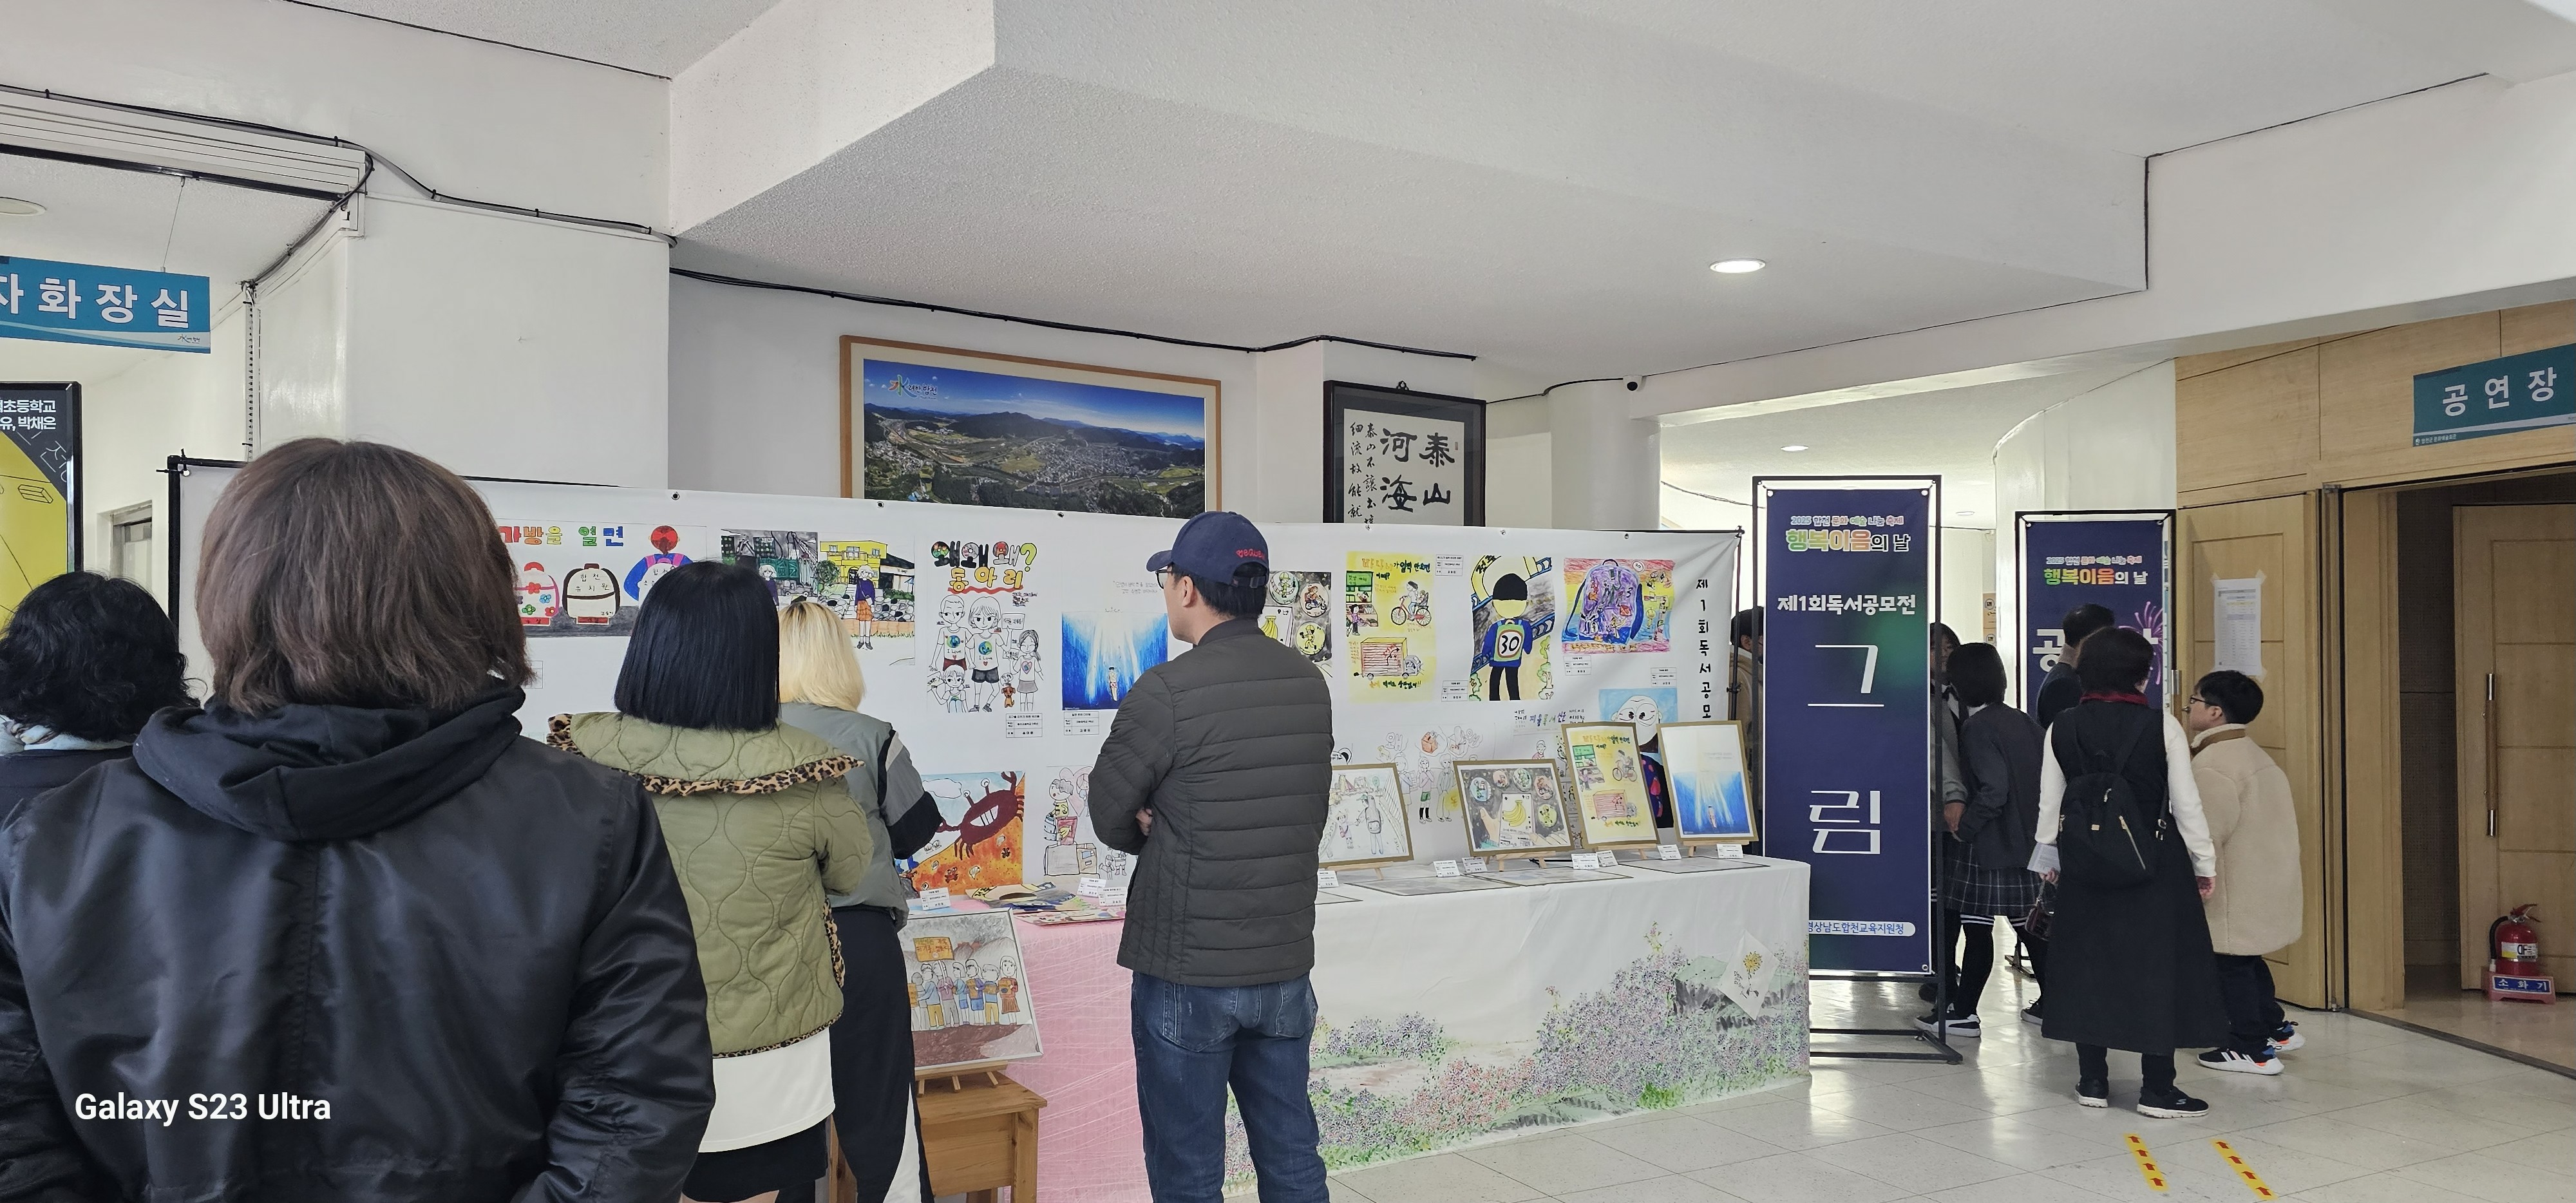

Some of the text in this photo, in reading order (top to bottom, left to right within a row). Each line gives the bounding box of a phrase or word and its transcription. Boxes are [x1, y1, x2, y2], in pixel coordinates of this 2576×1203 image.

[2443, 366, 2557, 417] 공연장
[0, 399, 57, 413] 초등학교
[18, 416, 57, 430] 박채은
[1791, 515, 1904, 526] 2025 합천 문화 예술 나눔 축제
[1786, 529, 1911, 552] 행복이음의 날
[949, 567, 1023, 592] 동아리
[2043, 569, 2148, 585] 행복이음의 날
[1777, 594, 1916, 616] 제1회독서공모전
[1501, 634, 1520, 654] 30
[2498, 978, 2547, 991] 소화기
